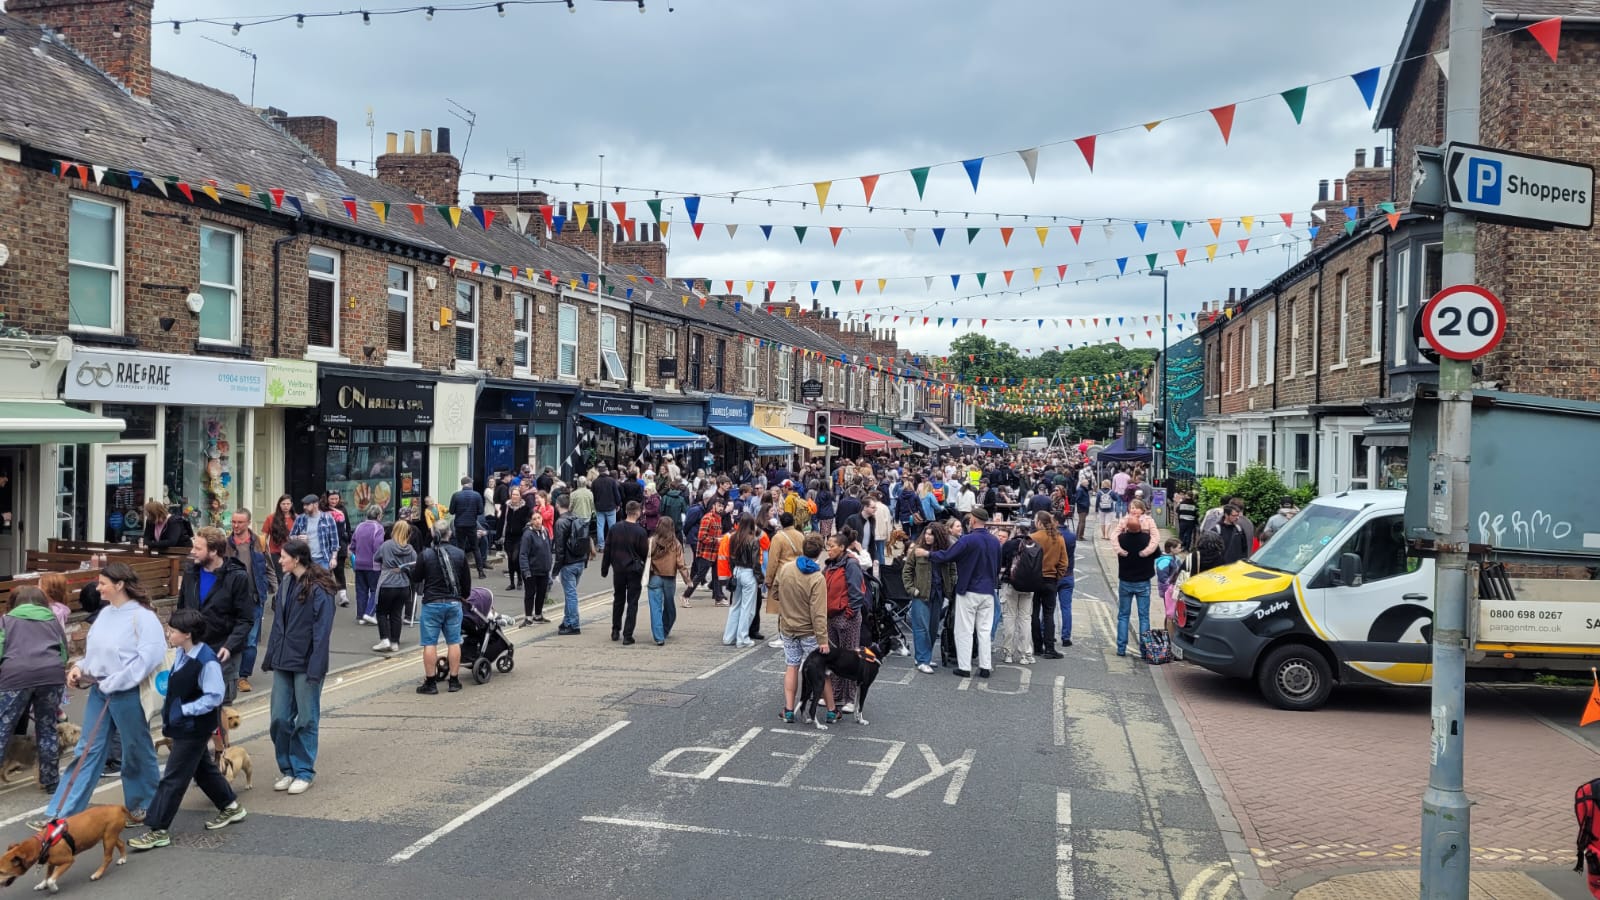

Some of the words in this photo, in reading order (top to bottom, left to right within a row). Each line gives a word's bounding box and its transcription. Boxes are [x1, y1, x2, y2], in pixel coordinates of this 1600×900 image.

[1476, 163, 1497, 199] P
[1507, 174, 1587, 204] Shoppers
[1438, 306, 1494, 336] 20
[116, 362, 141, 383] RAE
[148, 364, 171, 386] RAE
[218, 374, 239, 383] 01904
[338, 385, 366, 409] CN
[368, 397, 396, 409] NAILS
[398, 399, 405, 409] &
[407, 399, 424, 410] SPA
[1490, 609, 1514, 618] 0800
[1517, 610, 1535, 619] 698
[1538, 611, 1563, 619] 0267
[1489, 624, 1562, 633] paragontm.co.uk
[648, 726, 977, 805] KEEP
